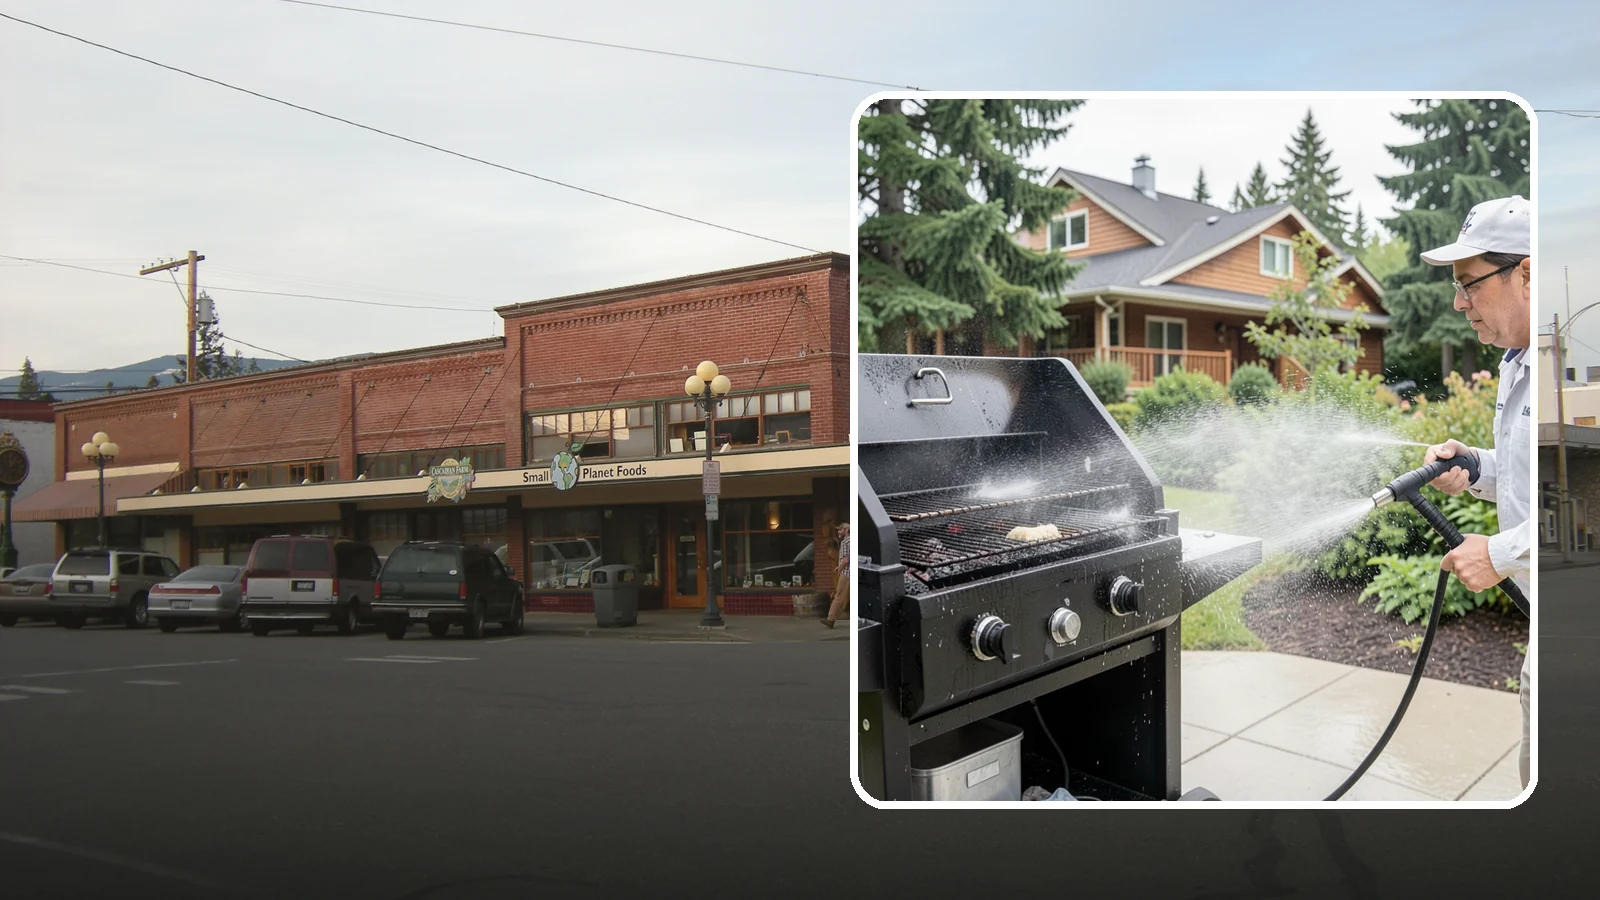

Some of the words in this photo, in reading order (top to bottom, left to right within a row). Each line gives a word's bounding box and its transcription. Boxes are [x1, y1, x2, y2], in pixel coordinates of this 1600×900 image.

[523, 471, 549, 483] Small
[582, 467, 614, 479] Planet
[617, 464, 647, 477] Foods
